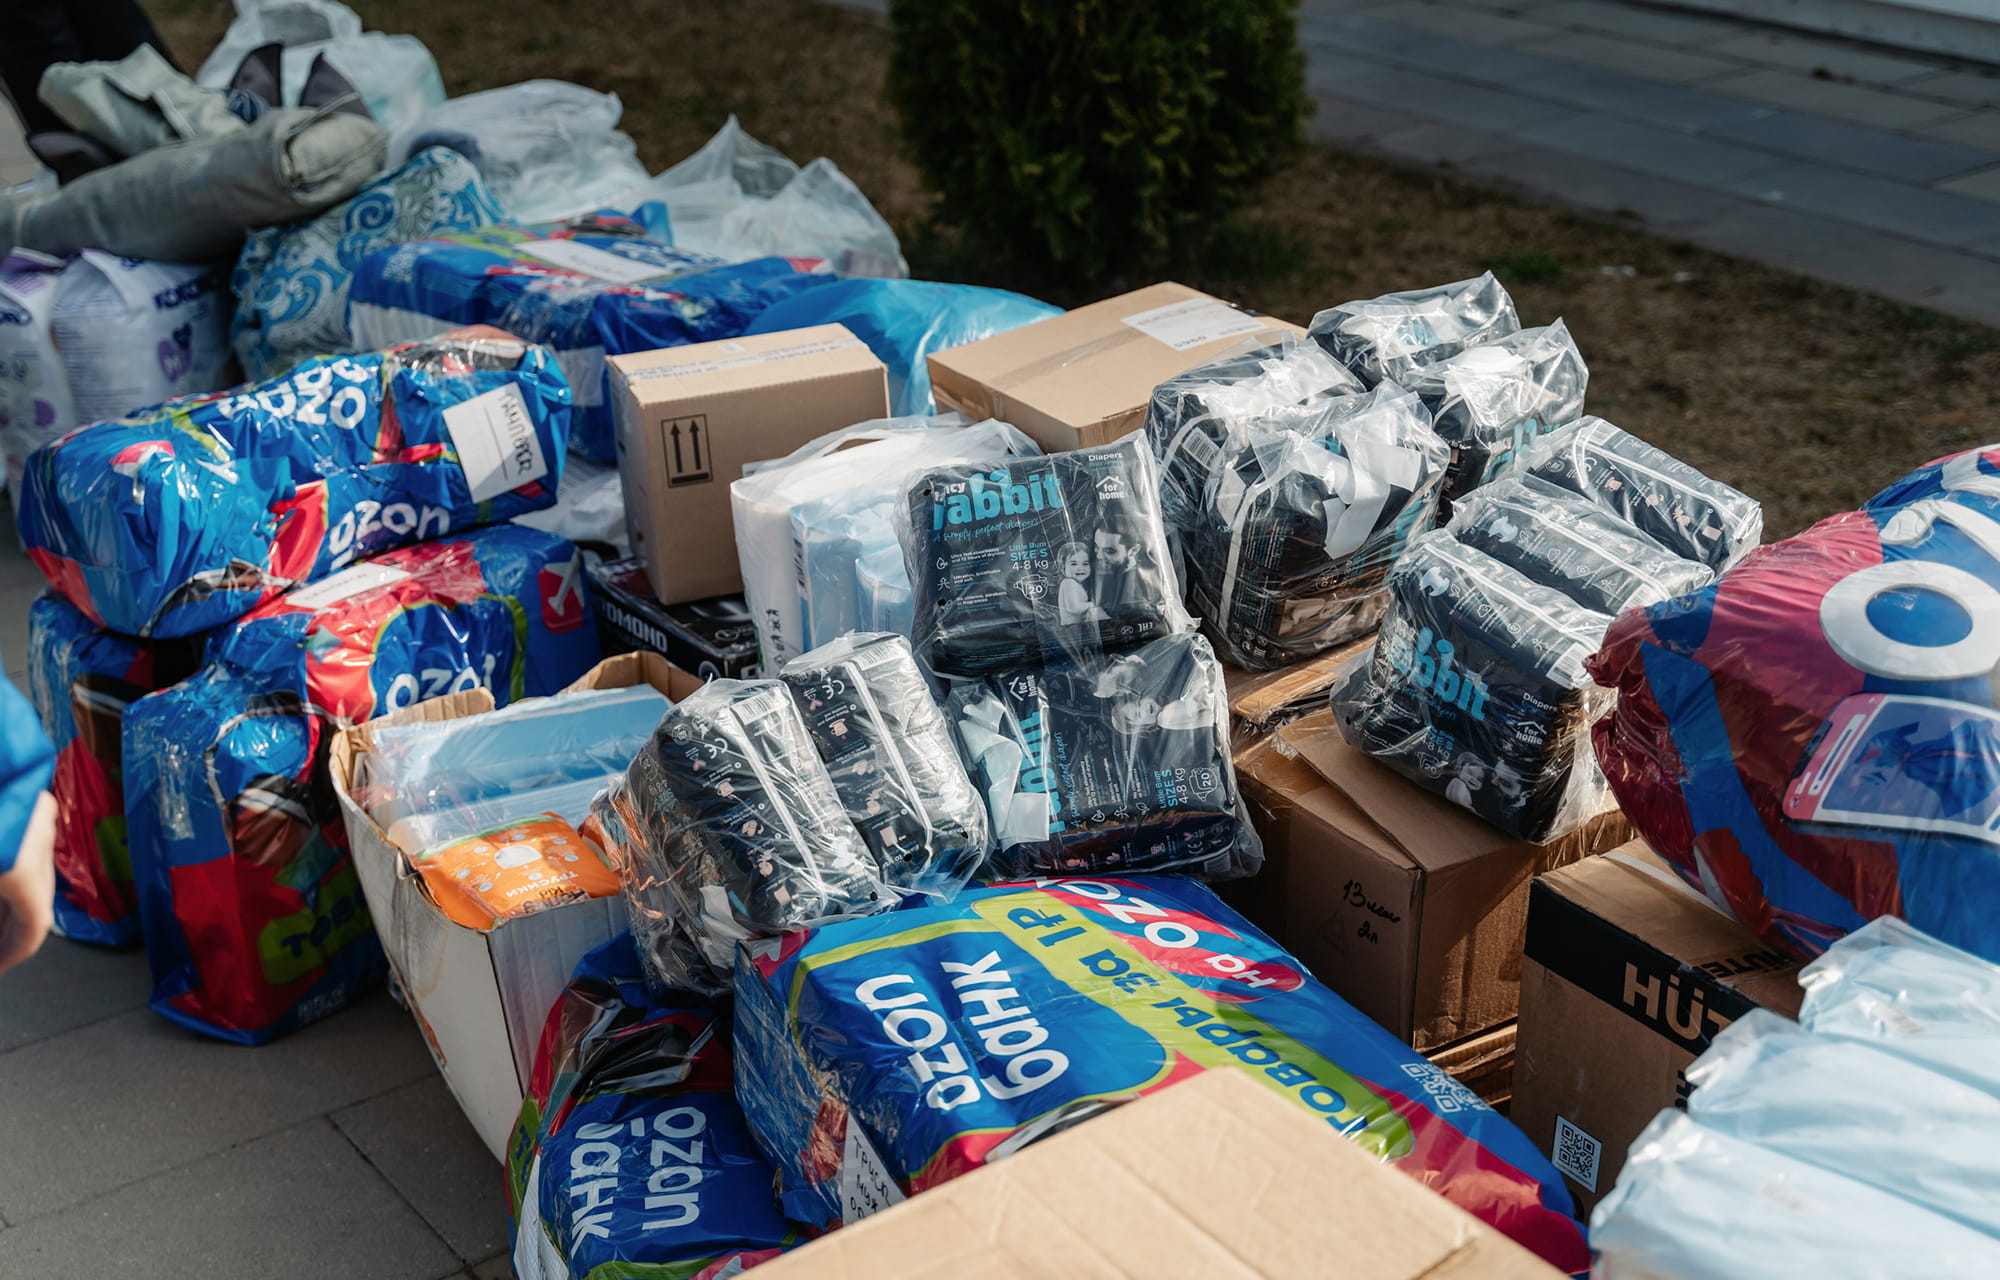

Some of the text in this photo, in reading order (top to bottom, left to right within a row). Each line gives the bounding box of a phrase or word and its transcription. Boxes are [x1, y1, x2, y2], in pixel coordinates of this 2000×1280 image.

[1088, 451, 1123, 463] Diapers
[1099, 490, 1125, 501] home
[1103, 483, 1119, 493] for
[329, 499, 450, 556] ozon
[1010, 548, 1048, 561] SIZE S
[1012, 559, 1049, 571] 4-8 kg
[1028, 585, 1043, 595] 20
[1018, 681, 1028, 694] for
[1027, 674, 1038, 698] home
[1522, 692, 1558, 713] Diapers
[1515, 731, 1544, 746] home
[1523, 725, 1540, 737] for
[1174, 767, 1189, 804] 4-8 kg
[1201, 772, 1212, 787] 20
[1161, 768, 1178, 807] SIZE S
[1078, 948, 1160, 995] за
[940, 949, 1071, 1102] банк
[854, 973, 983, 1112] ozon
[640, 1106, 707, 1233] ozon
